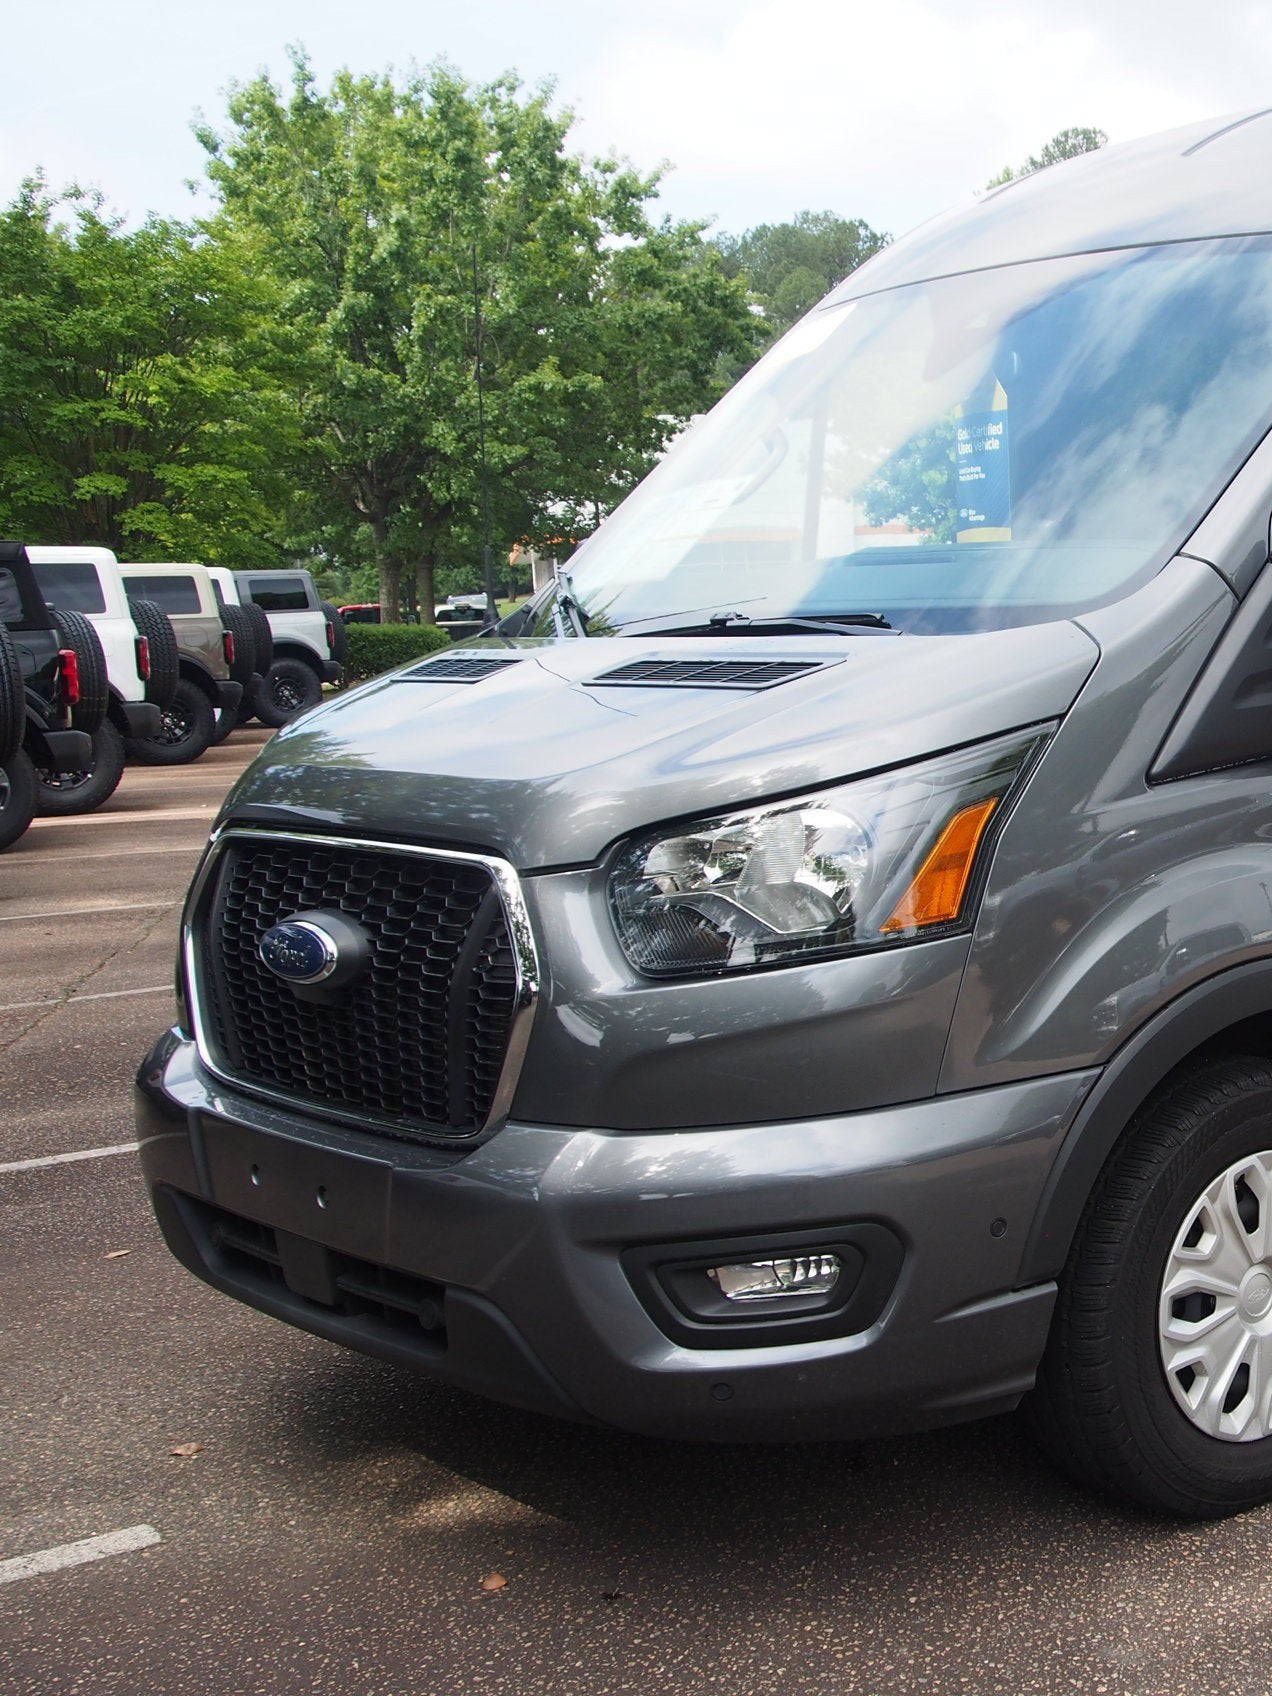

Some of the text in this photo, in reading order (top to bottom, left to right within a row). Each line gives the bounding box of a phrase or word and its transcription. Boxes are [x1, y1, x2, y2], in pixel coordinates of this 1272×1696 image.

[957, 422, 1003, 441] Gold Certified
[957, 437, 1000, 455] Used Vehicle
